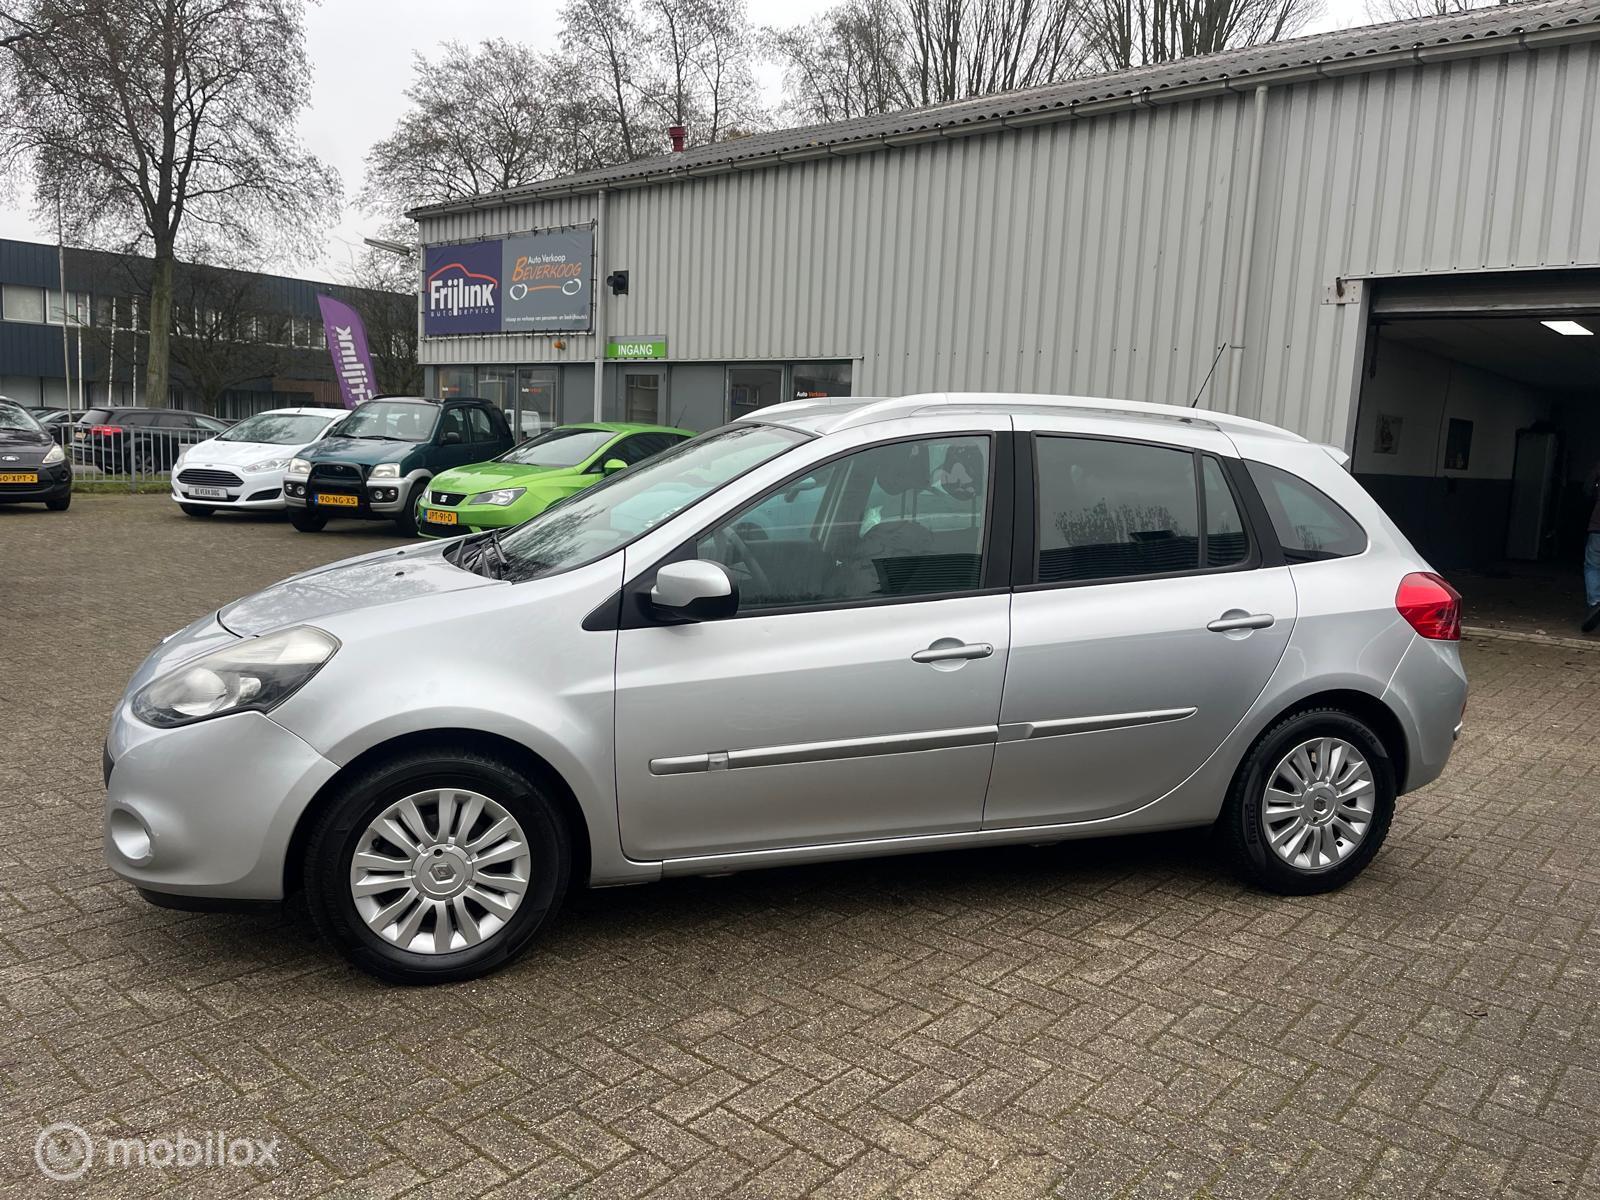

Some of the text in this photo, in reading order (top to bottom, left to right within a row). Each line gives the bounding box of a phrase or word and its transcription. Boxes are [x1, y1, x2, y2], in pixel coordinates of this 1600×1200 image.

[528, 253, 566, 264] Auto Verkoop
[511, 255, 582, 282] BEVERKOOG
[430, 278, 495, 316] Frijlink
[618, 344, 653, 356] INGANG
[319, 495, 356, 505] 90-NG-XS
